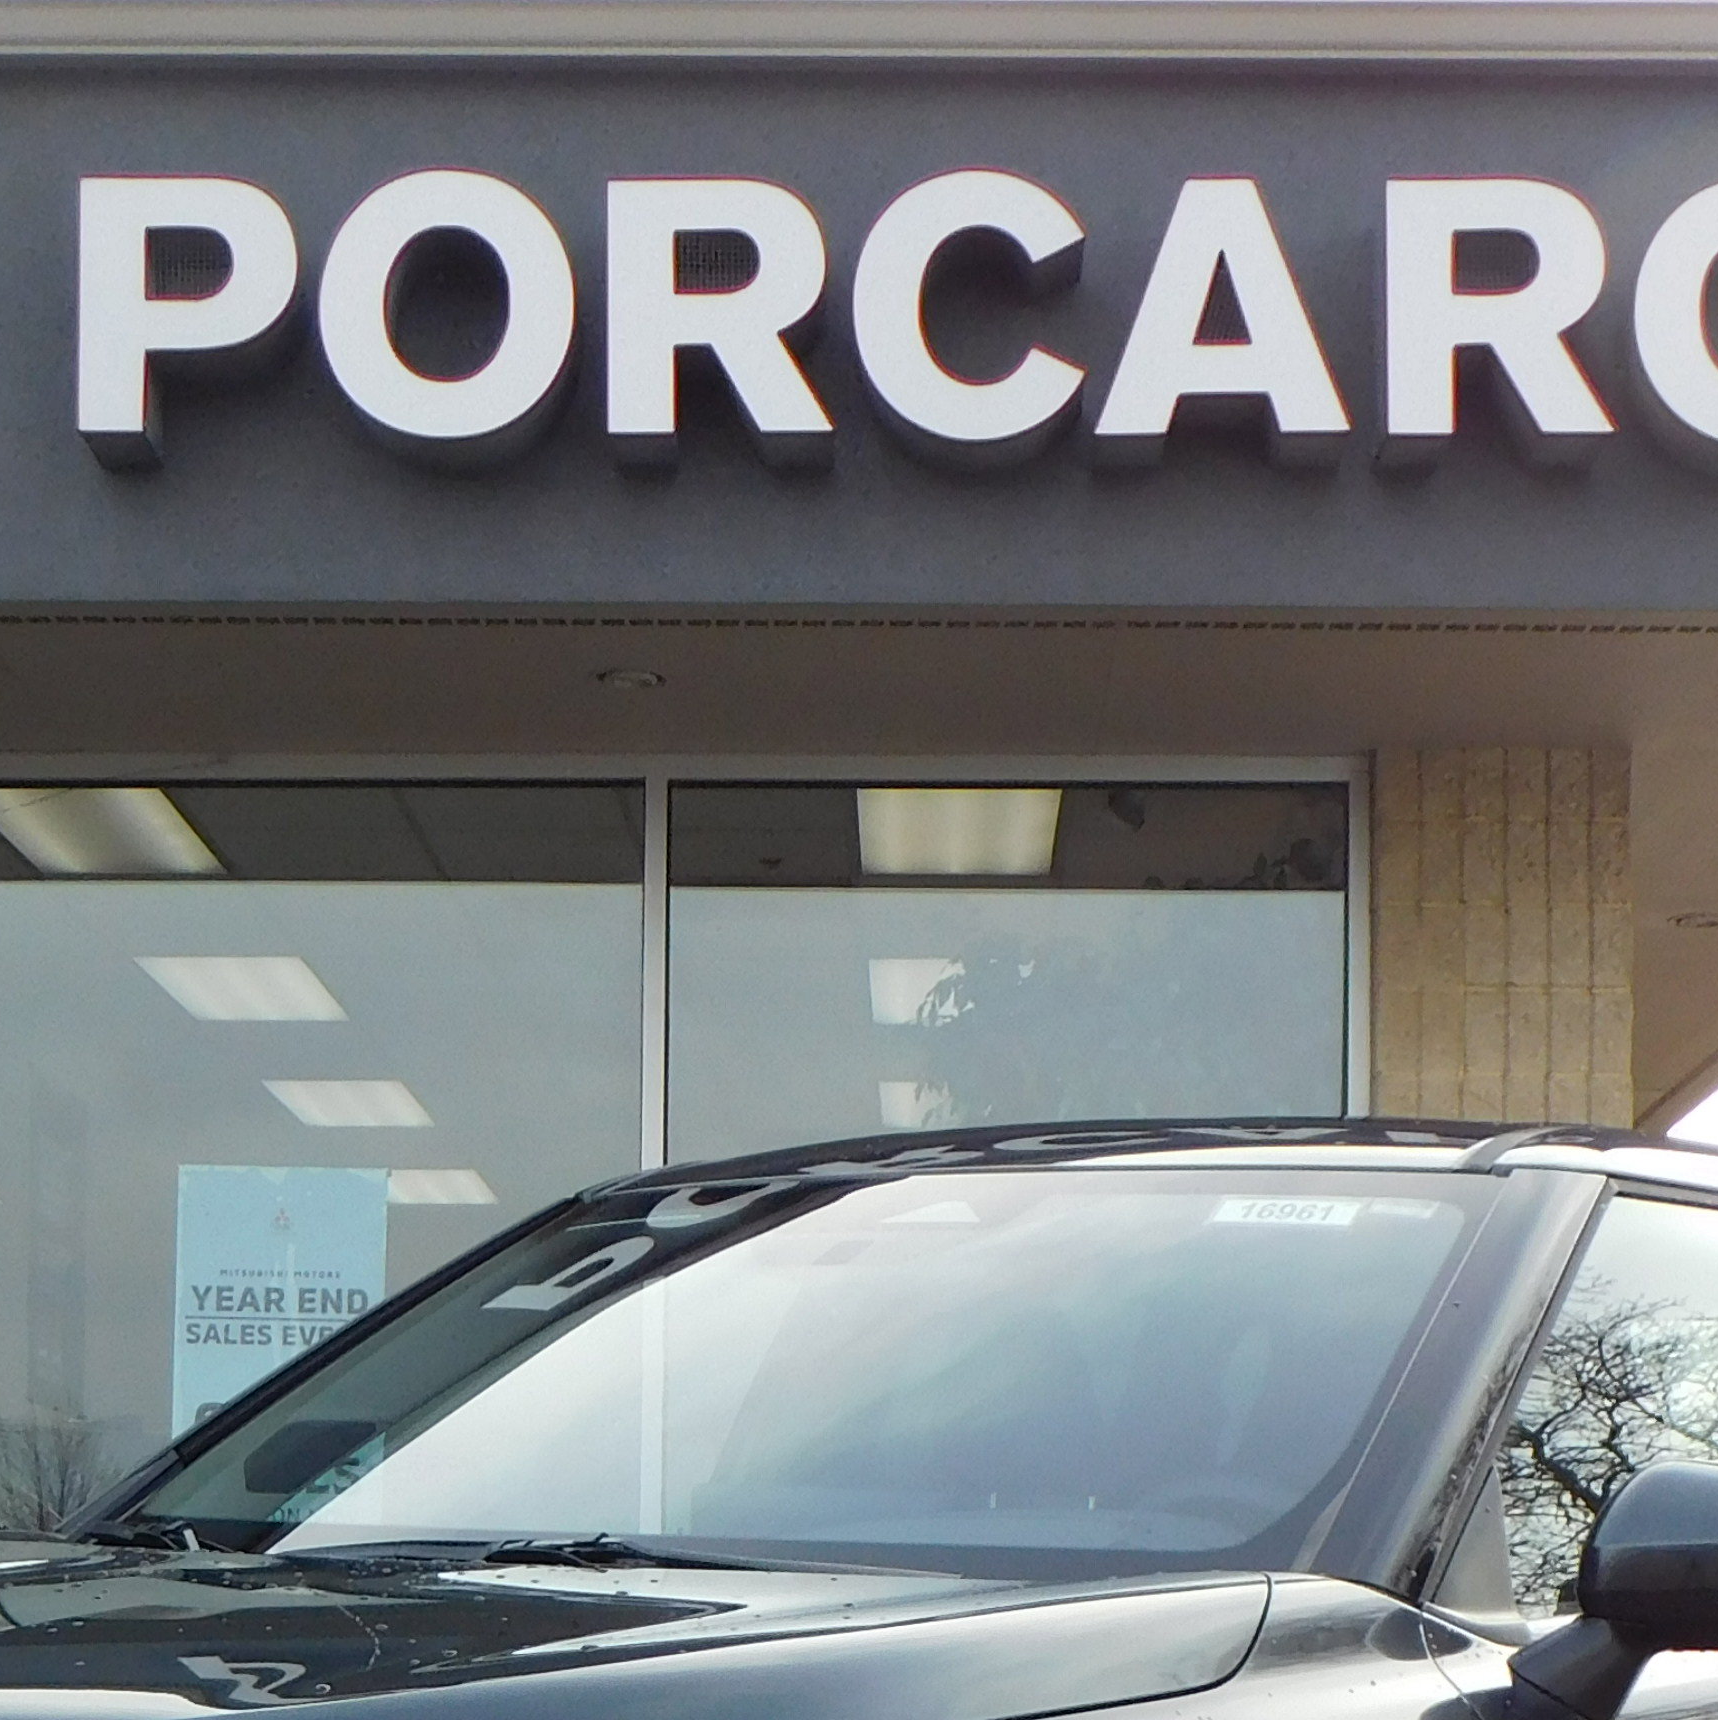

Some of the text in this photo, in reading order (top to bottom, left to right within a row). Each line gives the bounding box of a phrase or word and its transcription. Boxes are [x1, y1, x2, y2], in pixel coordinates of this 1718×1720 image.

[1241, 1202, 1335, 1221] 16961
[191, 1284, 369, 1314] YEAR END
[186, 1322, 273, 1346] SALES
